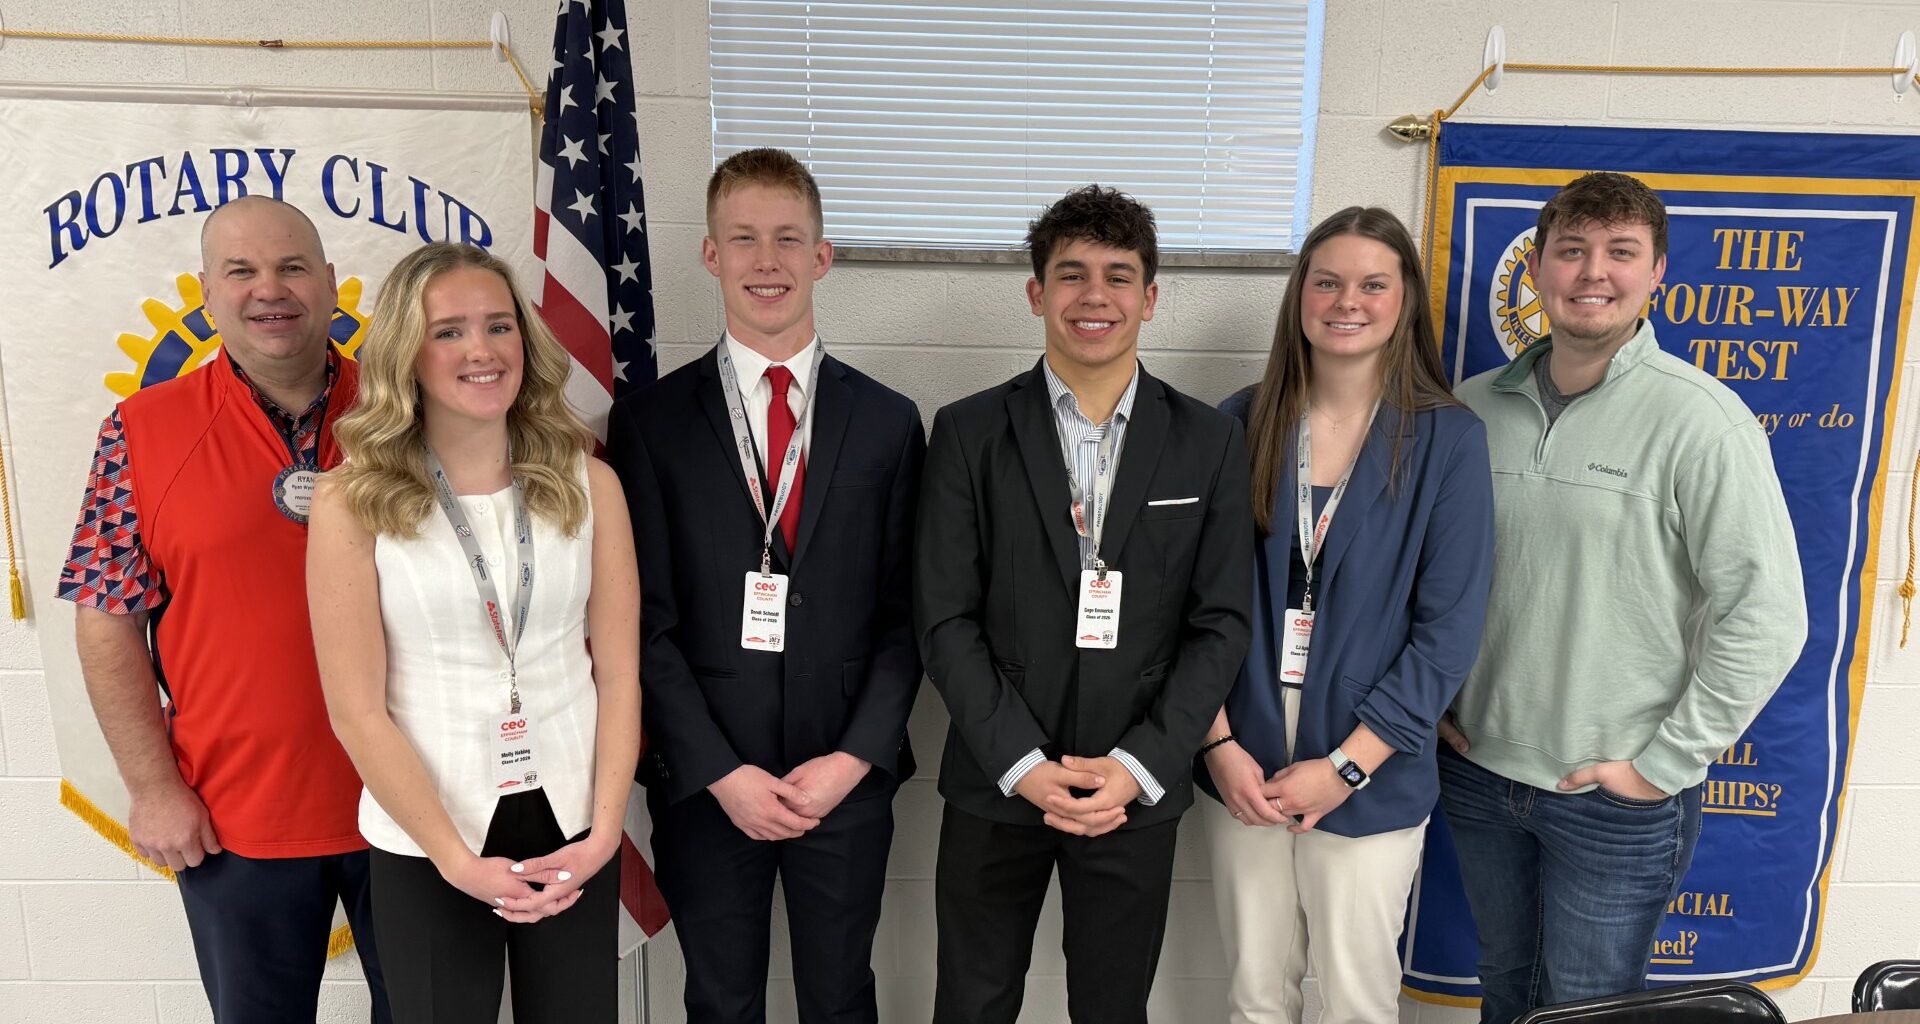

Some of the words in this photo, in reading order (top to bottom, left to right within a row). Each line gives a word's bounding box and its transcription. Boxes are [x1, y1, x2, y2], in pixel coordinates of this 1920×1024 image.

[43, 148, 296, 270] ROTARY
[322, 154, 492, 256] CLUB
[1713, 228, 1805, 272] THE
[1639, 283, 1860, 327] FOUR-WAY
[1688, 339, 1798, 381] TEST
[1788, 413, 1811, 428] or
[1818, 403, 1855, 428] do
[280, 464, 310, 480] ROTARY
[1595, 464, 1628, 478] Columbia
[501, 719, 526, 731] ceo
